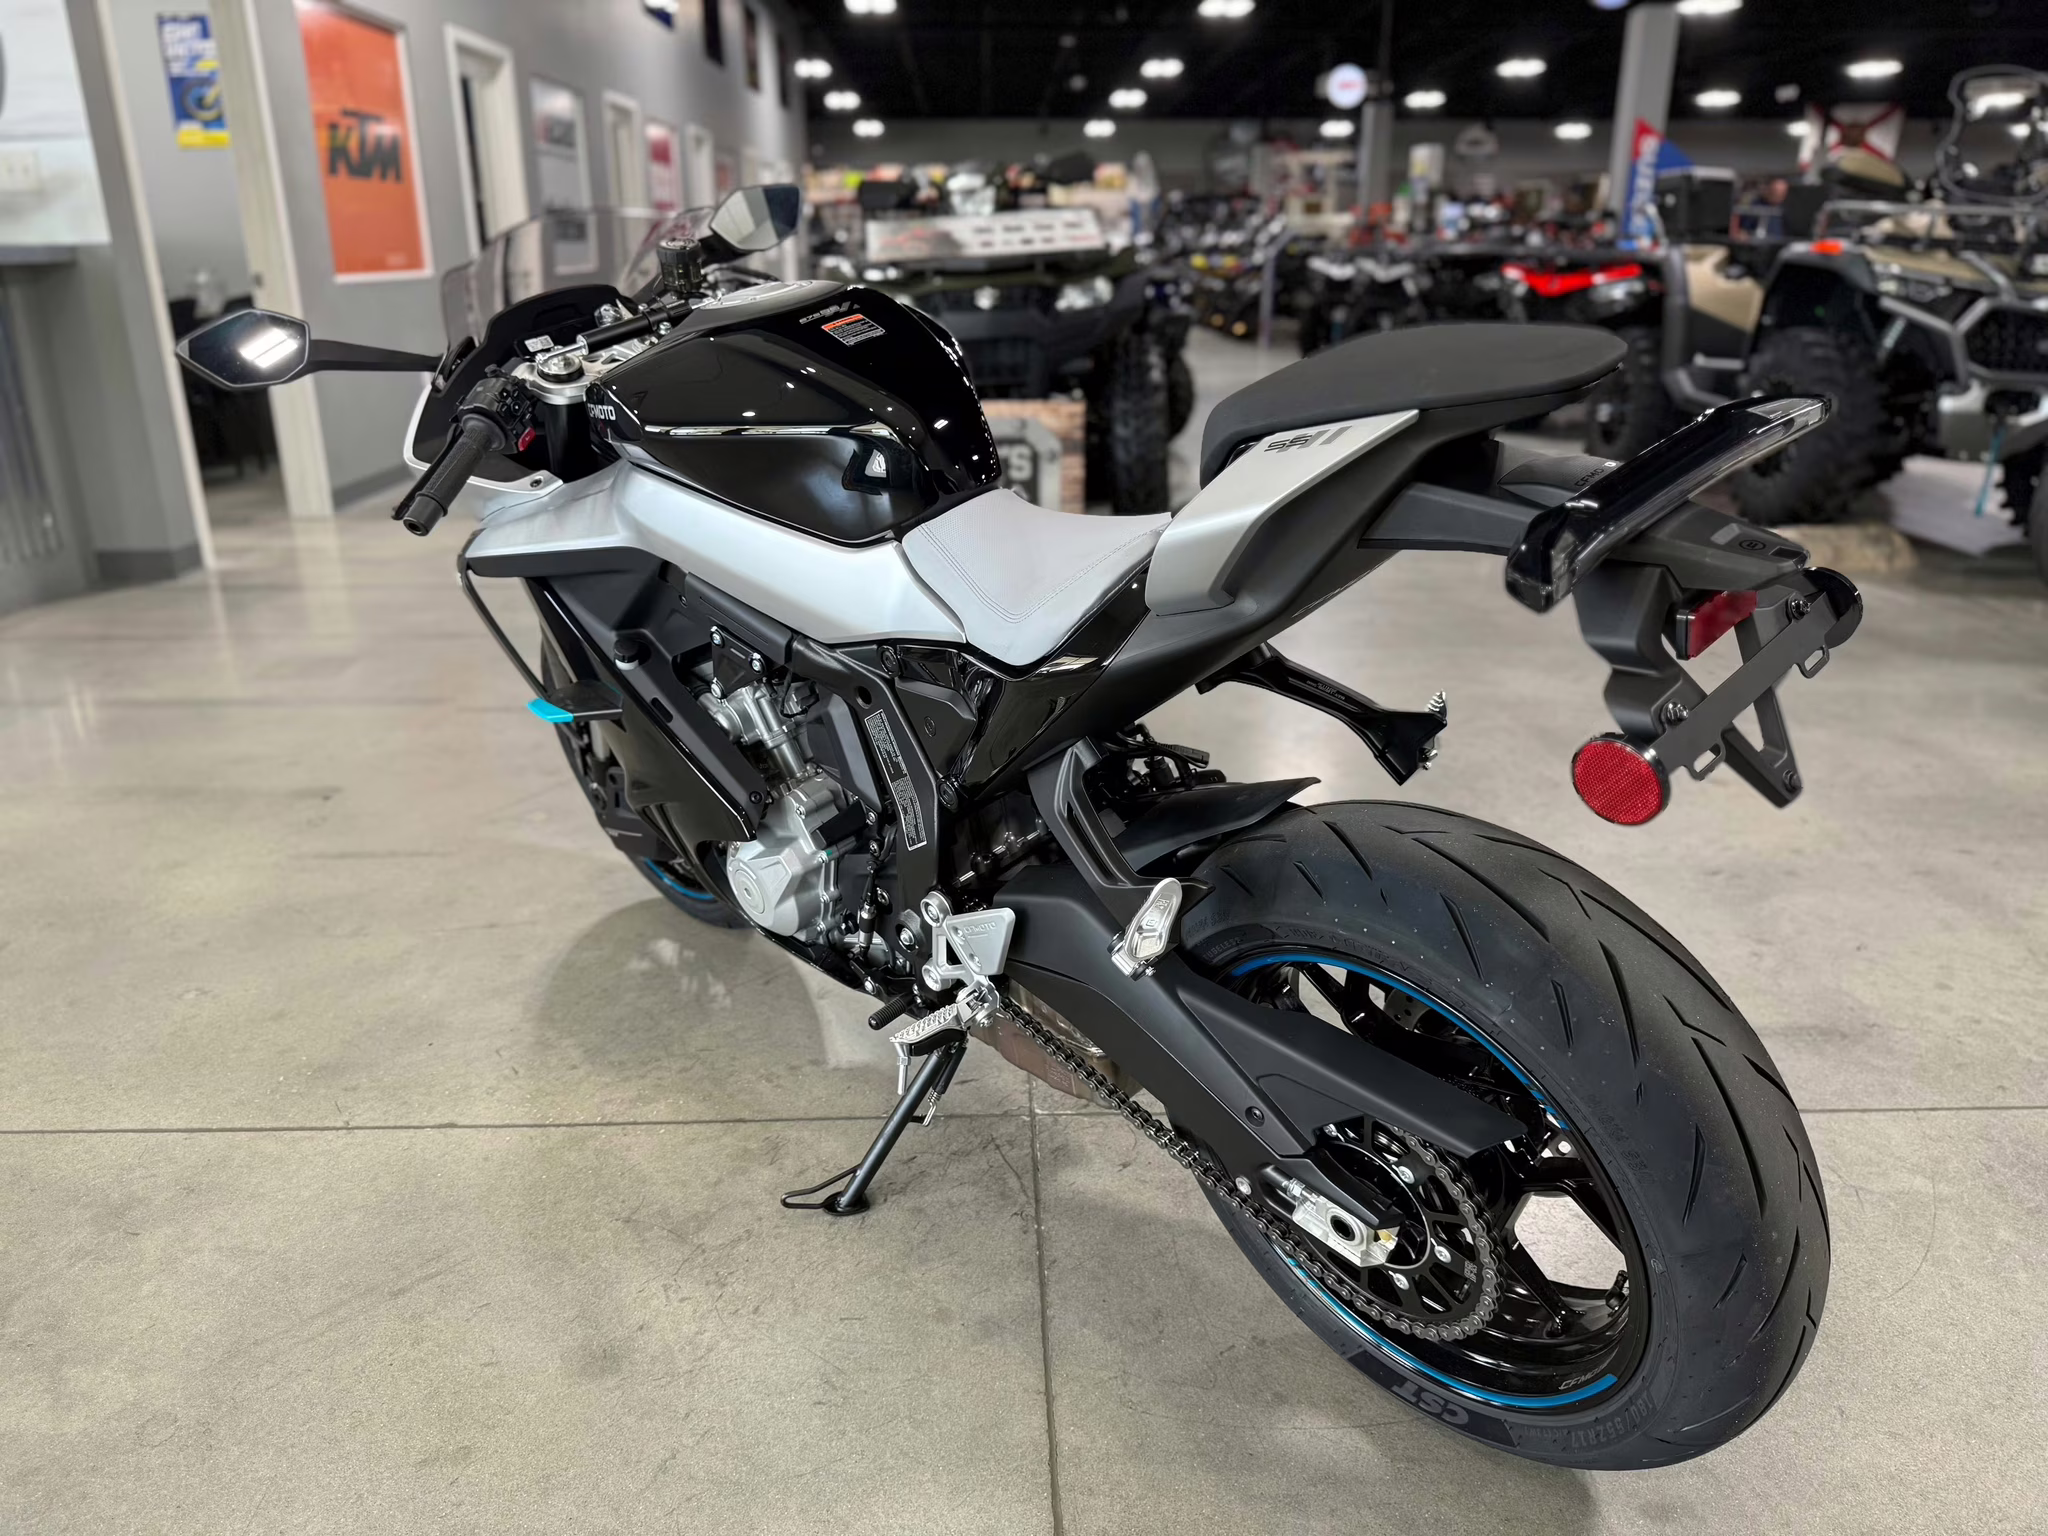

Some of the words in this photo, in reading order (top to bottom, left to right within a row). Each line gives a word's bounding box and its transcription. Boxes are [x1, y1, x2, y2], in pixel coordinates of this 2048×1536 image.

[328, 109, 402, 183] KTM
[588, 403, 616, 420] CFMOTO
[1391, 1379, 1469, 1425] CST
